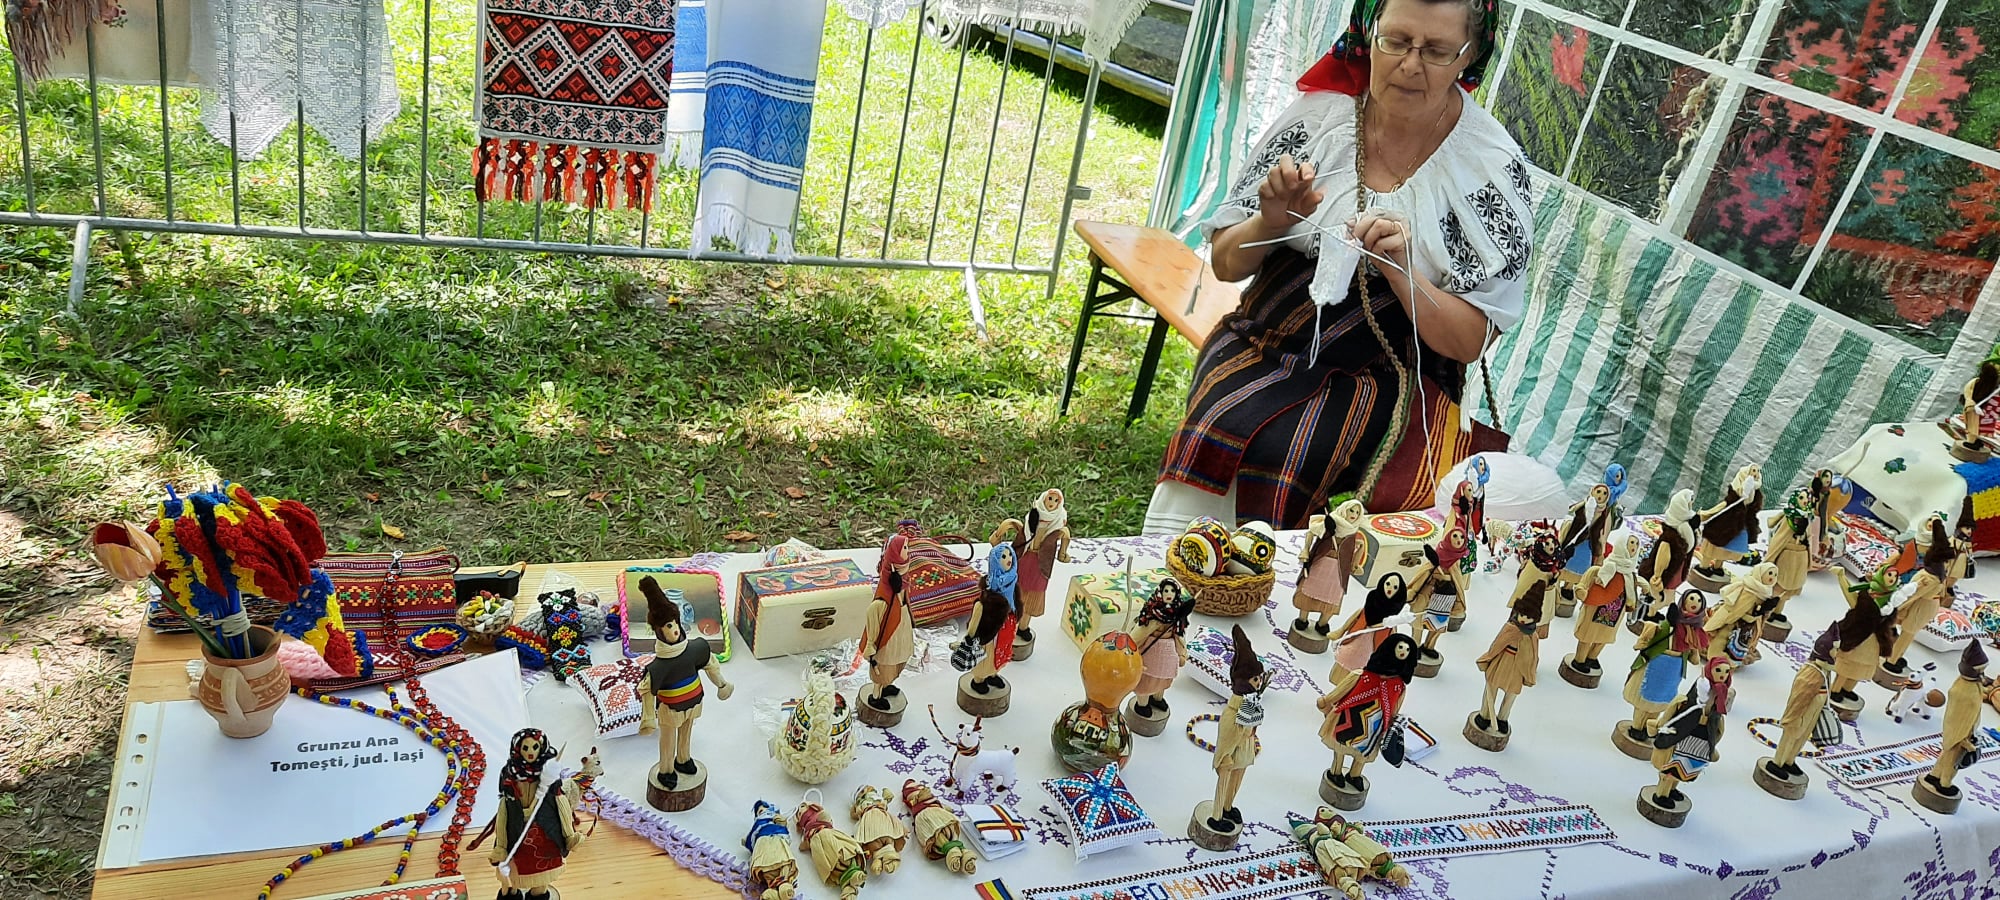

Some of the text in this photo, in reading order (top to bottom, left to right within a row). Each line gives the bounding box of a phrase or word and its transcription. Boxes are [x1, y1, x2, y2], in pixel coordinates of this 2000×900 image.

[297, 737, 399, 753] Grunzu Ana
[352, 752, 389, 768] jud.
[1430, 819, 1530, 843] ROMANIA
[1128, 871, 1242, 900] ROMANIA
